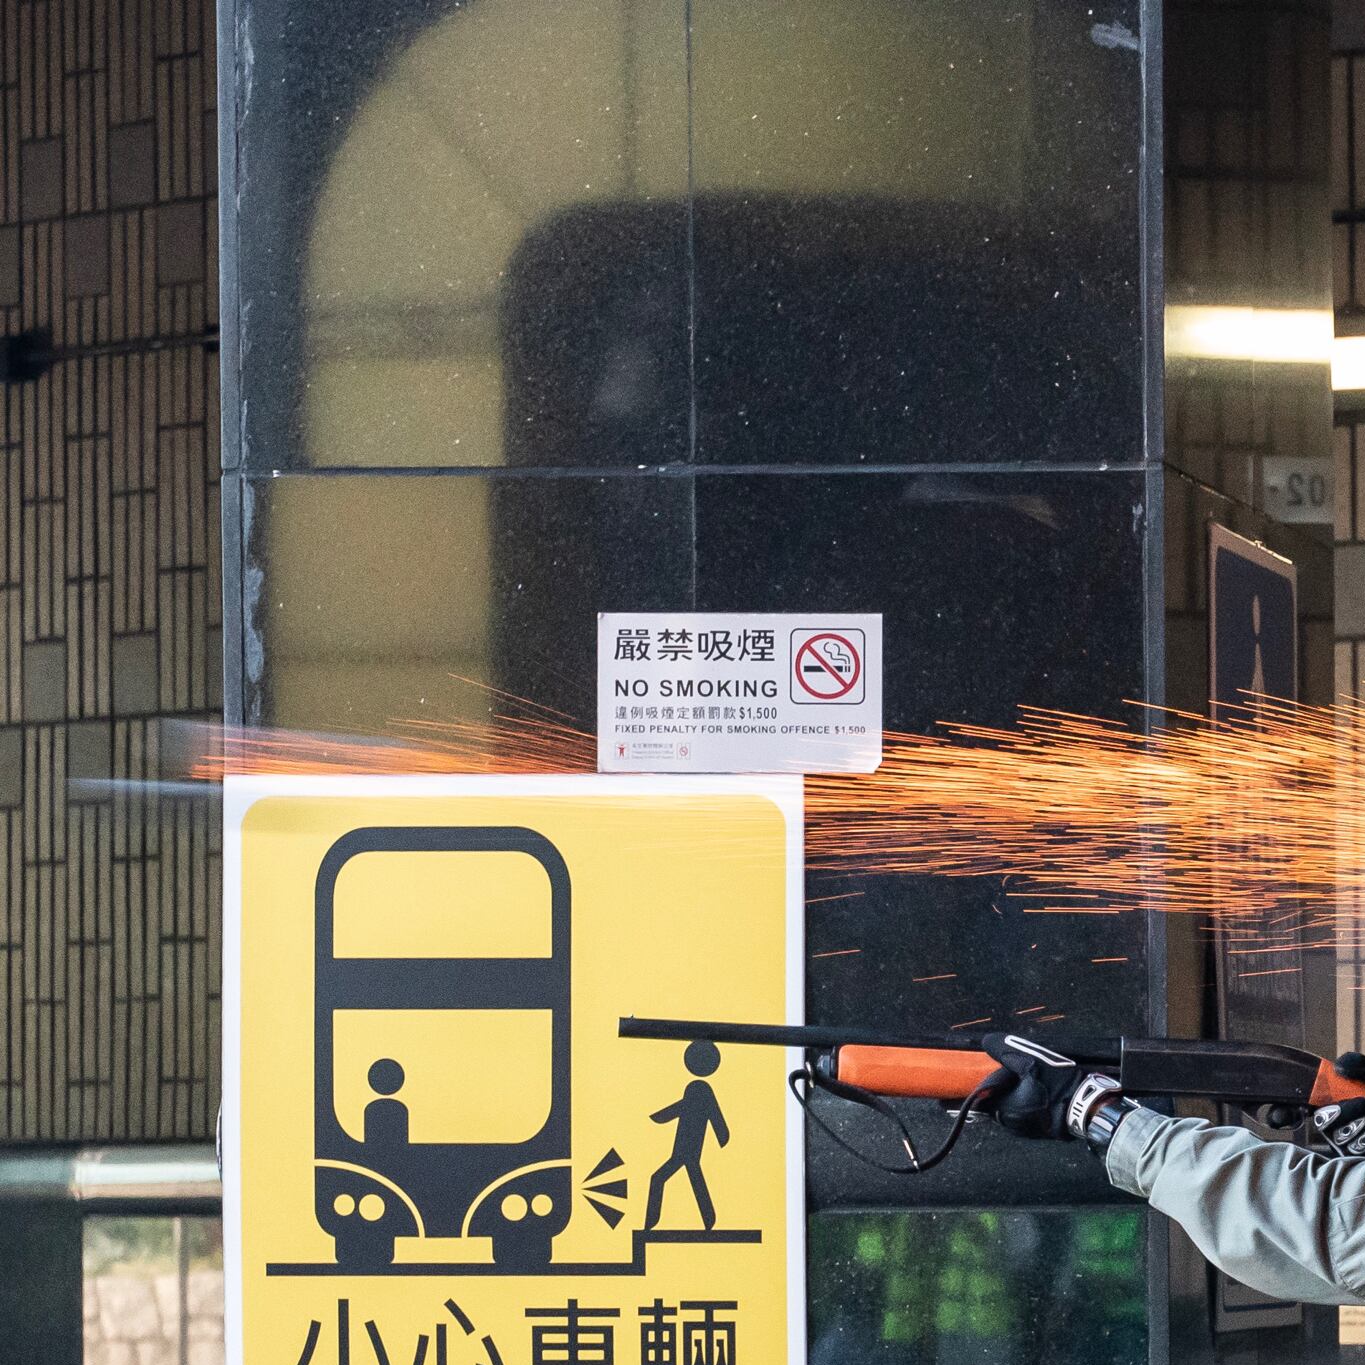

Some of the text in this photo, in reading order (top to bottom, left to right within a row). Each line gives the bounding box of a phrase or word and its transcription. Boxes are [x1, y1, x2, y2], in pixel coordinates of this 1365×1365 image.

[613, 628, 776, 662] 嚴禁吸煙
[614, 679, 778, 698] NO SMOKING
[614, 724, 866, 736] FIXED PENALTY FOR SMOKING OFFENCE $1,500
